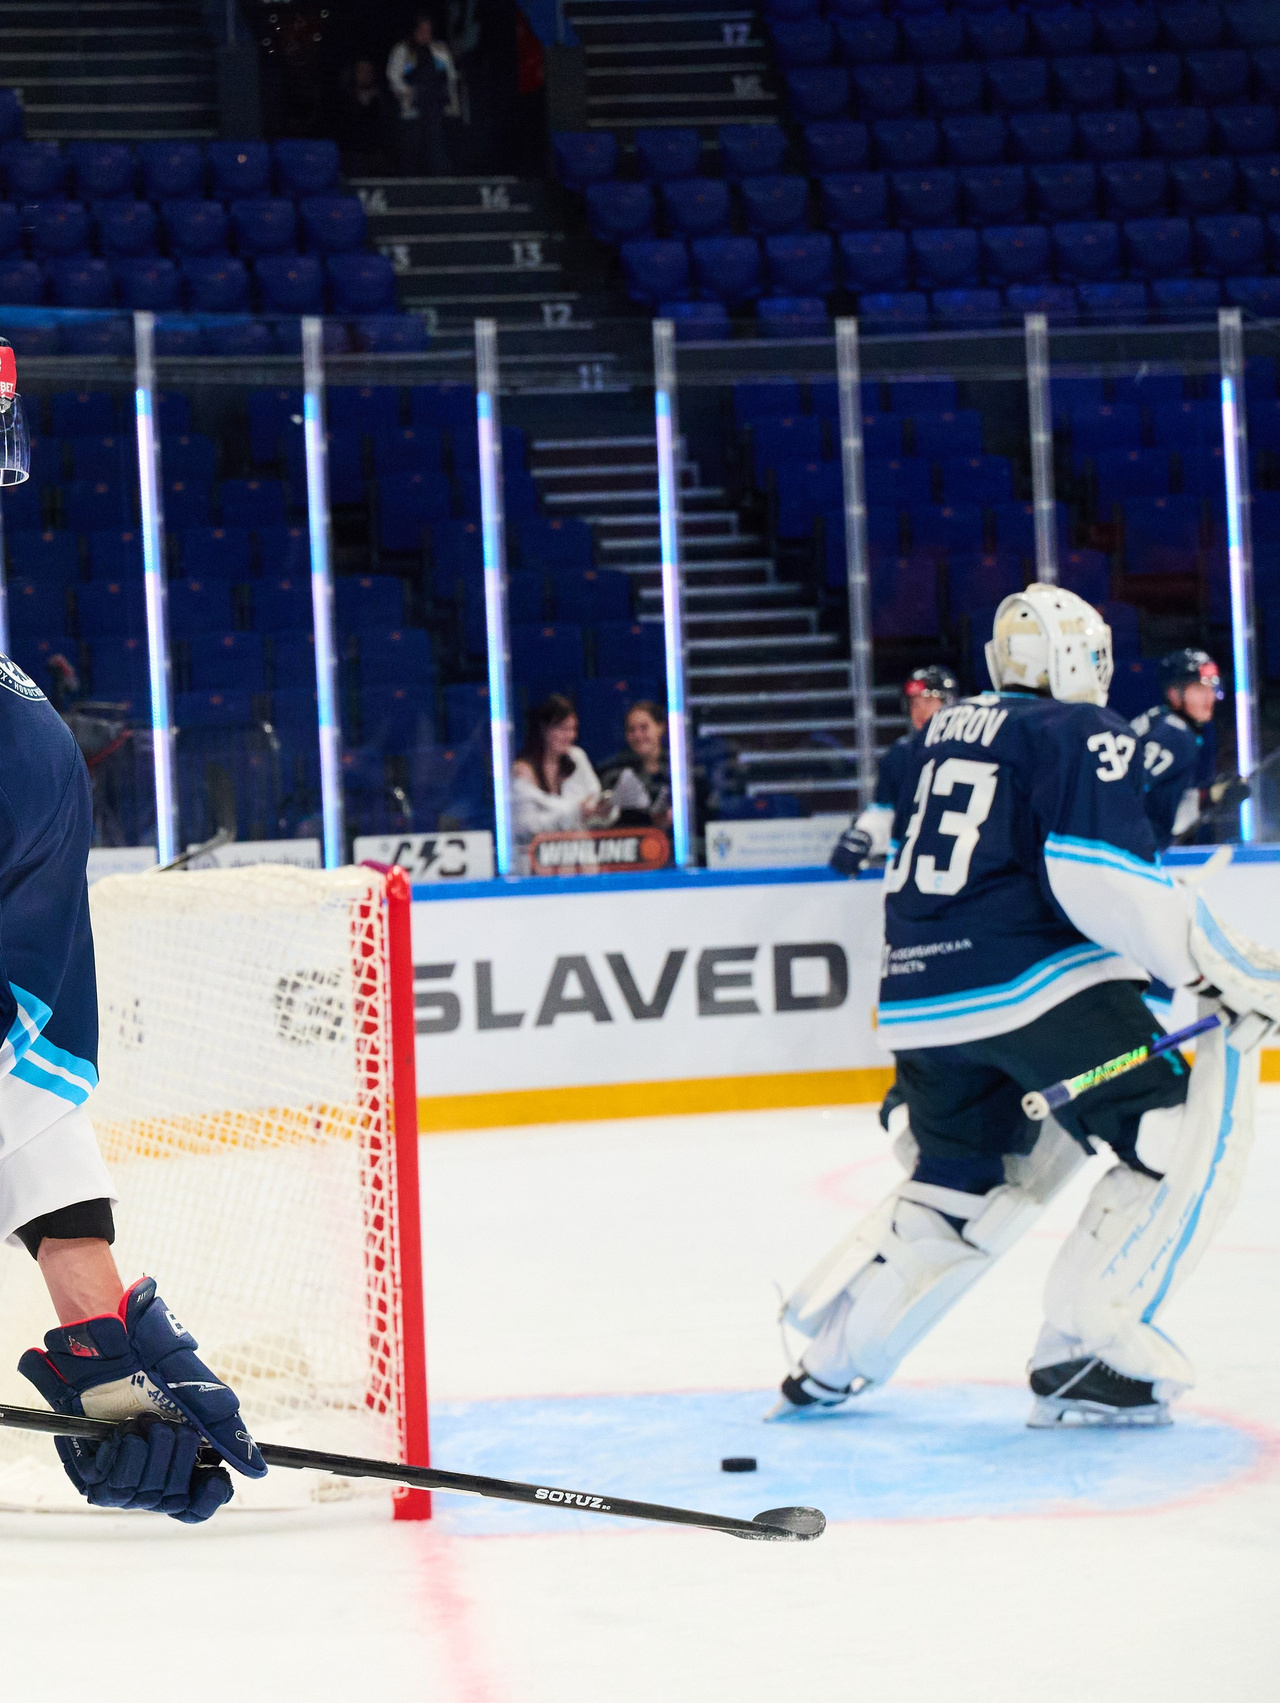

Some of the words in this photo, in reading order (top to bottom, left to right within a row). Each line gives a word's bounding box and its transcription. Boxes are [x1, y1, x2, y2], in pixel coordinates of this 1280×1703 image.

[511, 242, 543, 268] 13
[538, 838, 638, 866] WINLINE
[131, 1374, 145, 1389] 14
[535, 1488, 604, 1509] SOYUZ
